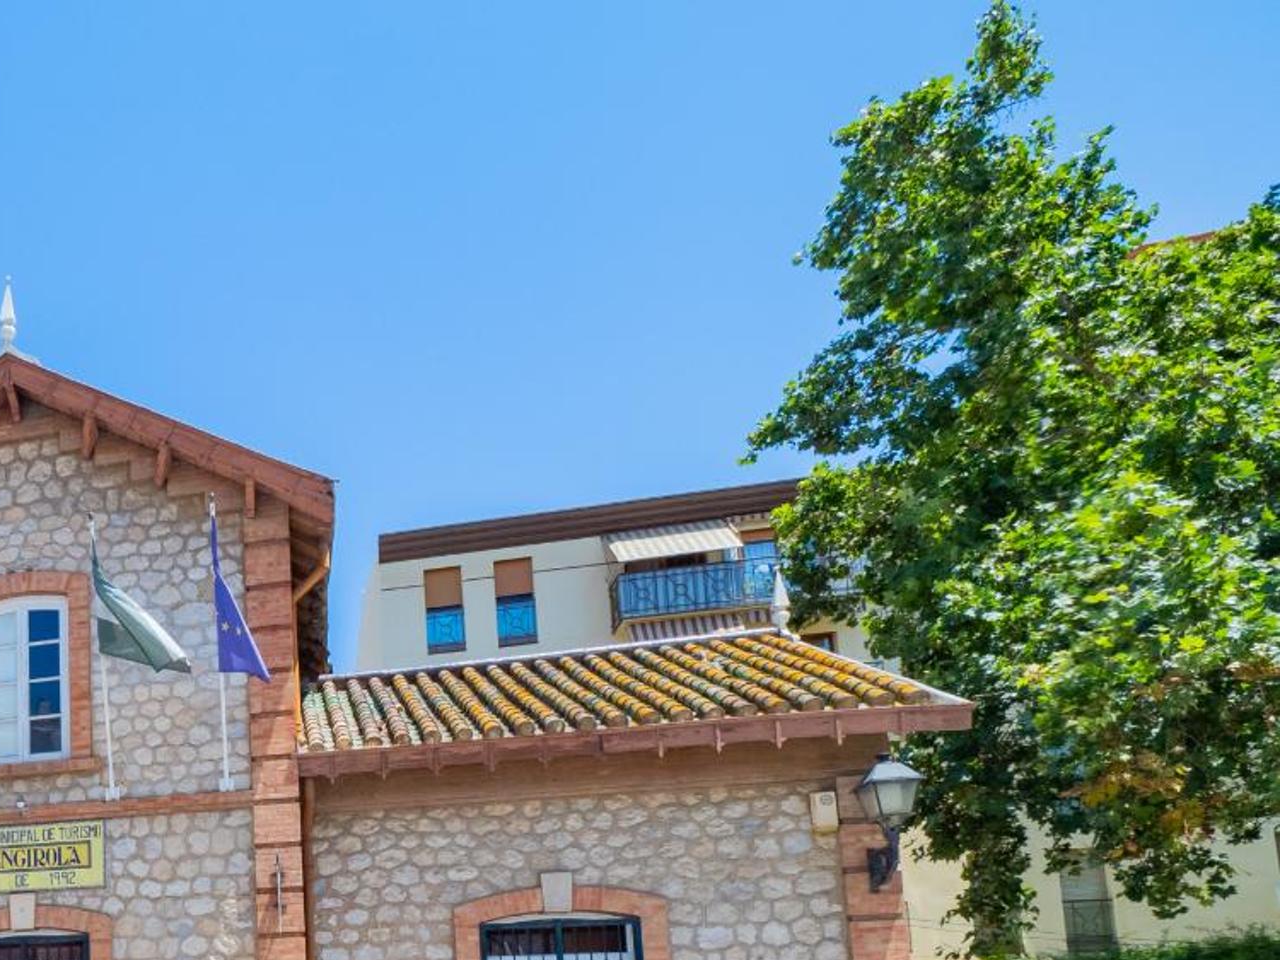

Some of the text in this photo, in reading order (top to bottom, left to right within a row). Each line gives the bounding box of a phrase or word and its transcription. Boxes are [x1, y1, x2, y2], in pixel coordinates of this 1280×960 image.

[42, 826, 57, 842] DE
[60, 824, 102, 841] TURISMO
[14, 873, 30, 888] DE
[49, 871, 76, 886] 1992
